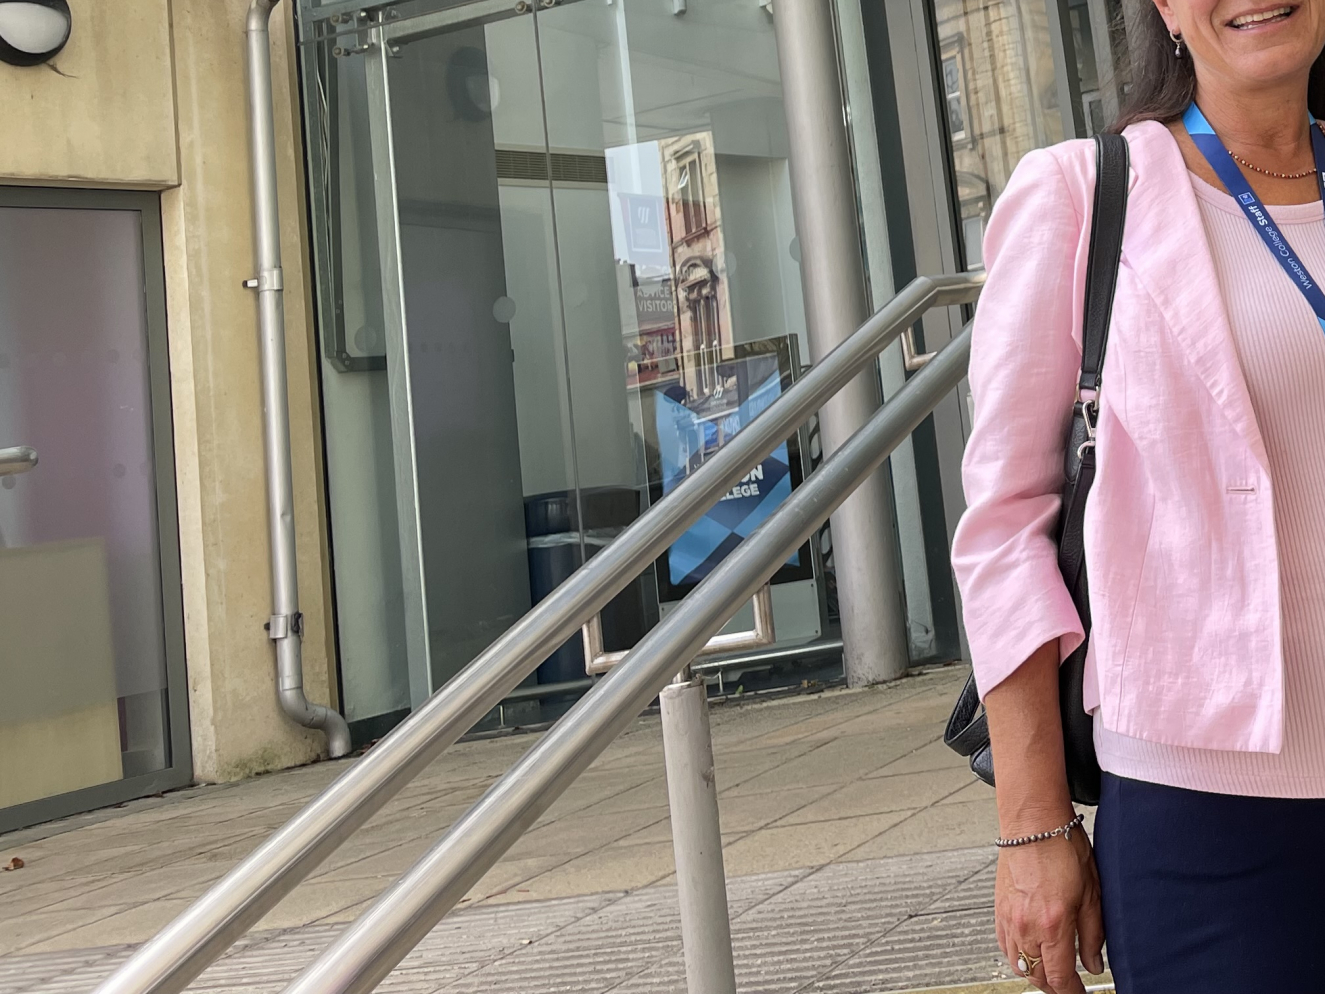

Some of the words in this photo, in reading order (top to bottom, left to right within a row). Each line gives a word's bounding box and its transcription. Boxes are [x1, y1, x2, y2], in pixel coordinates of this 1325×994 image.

[1248, 205, 1268, 226] Staff
[1265, 226, 1289, 257] College
[1288, 258, 1312, 289] Weston
[720, 483, 760, 501] LEGE
